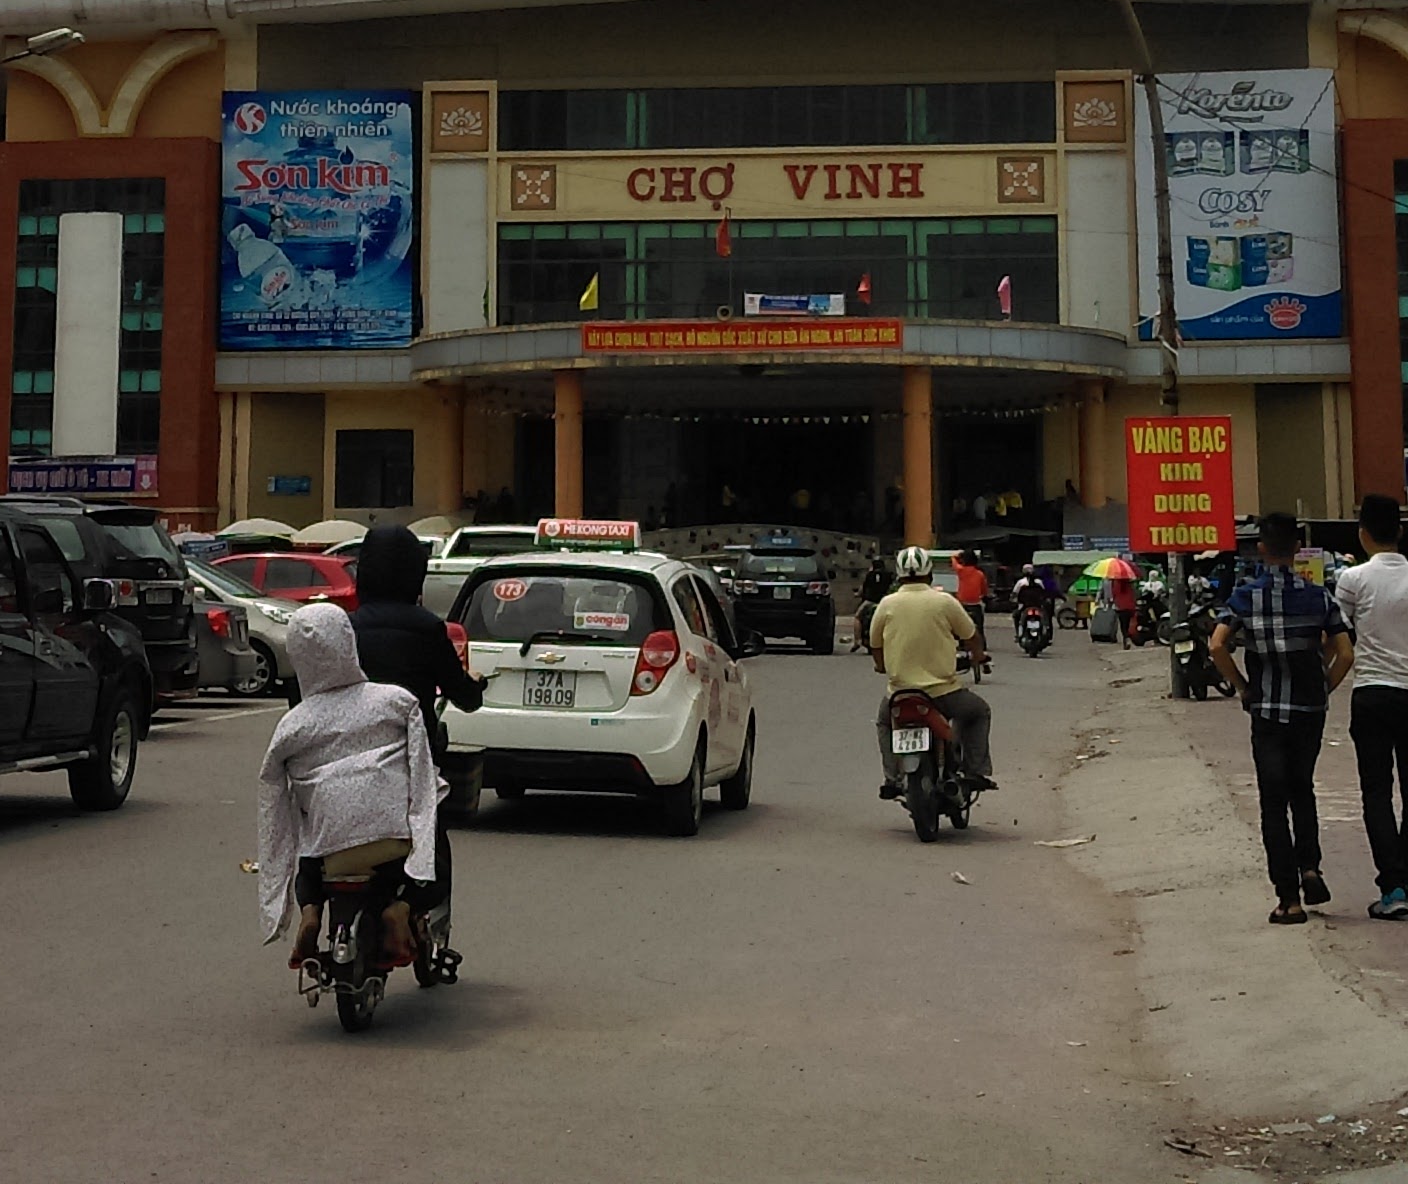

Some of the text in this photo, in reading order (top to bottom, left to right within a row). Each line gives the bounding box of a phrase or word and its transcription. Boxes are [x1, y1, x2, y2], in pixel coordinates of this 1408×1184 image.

[271, 98, 397, 117] Nước khoáng
[281, 121, 388, 137] thiên nhiên
[234, 157, 389, 194] Sơn kim
[627, 162, 924, 211] CHỢ VINH
[1132, 421, 1226, 458] VÀNG BẠC
[1160, 463, 1203, 481] KIM
[1154, 494, 1211, 512] DUNG
[1150, 523, 1218, 545] THÔNG
[498, 582, 522, 596] 173
[537, 671, 564, 688] 37A
[527, 688, 573, 706] 198.09
